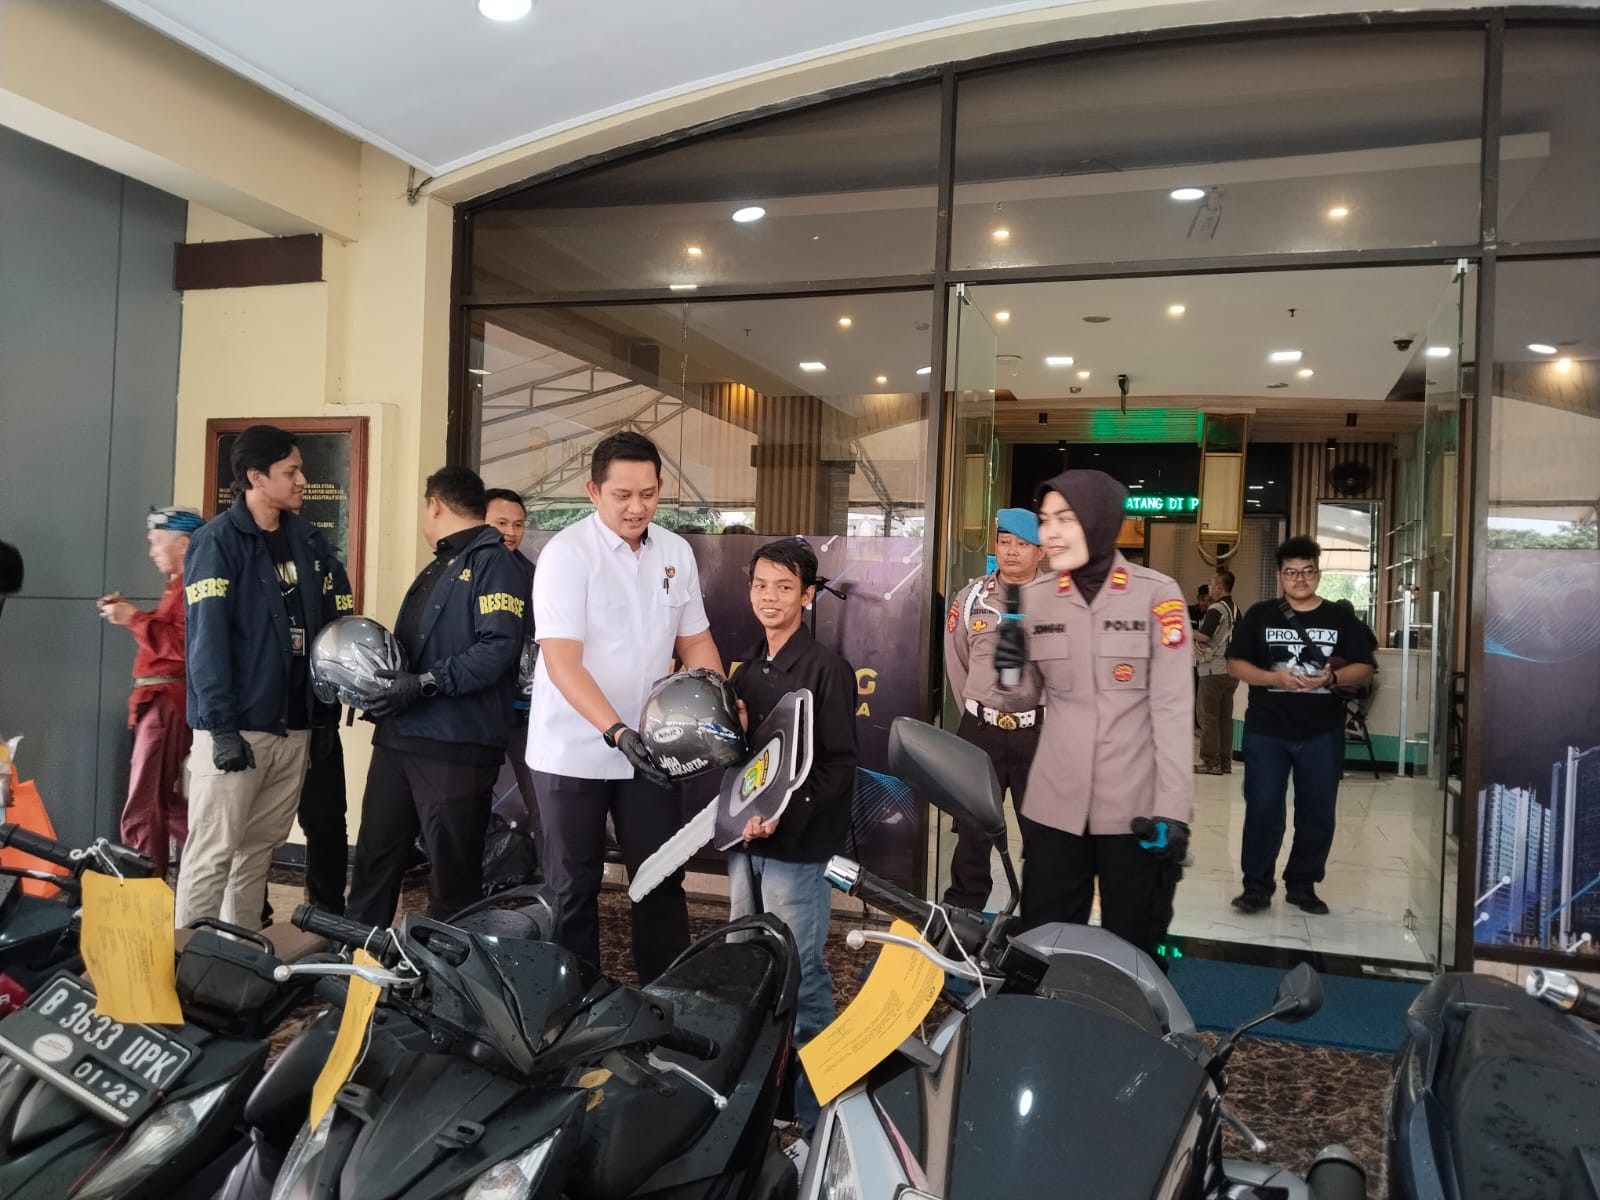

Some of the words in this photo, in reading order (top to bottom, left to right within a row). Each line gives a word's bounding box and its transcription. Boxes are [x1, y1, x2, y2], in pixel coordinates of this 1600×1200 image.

[1169, 497, 1184, 511] DI
[1103, 620, 1146, 632] POLRI
[1267, 630, 1325, 641] PROJCT
[1327, 631, 1336, 642] X
[39, 988, 69, 1016] B
[58, 1001, 124, 1051] 3633
[119, 1036, 178, 1084] UPK
